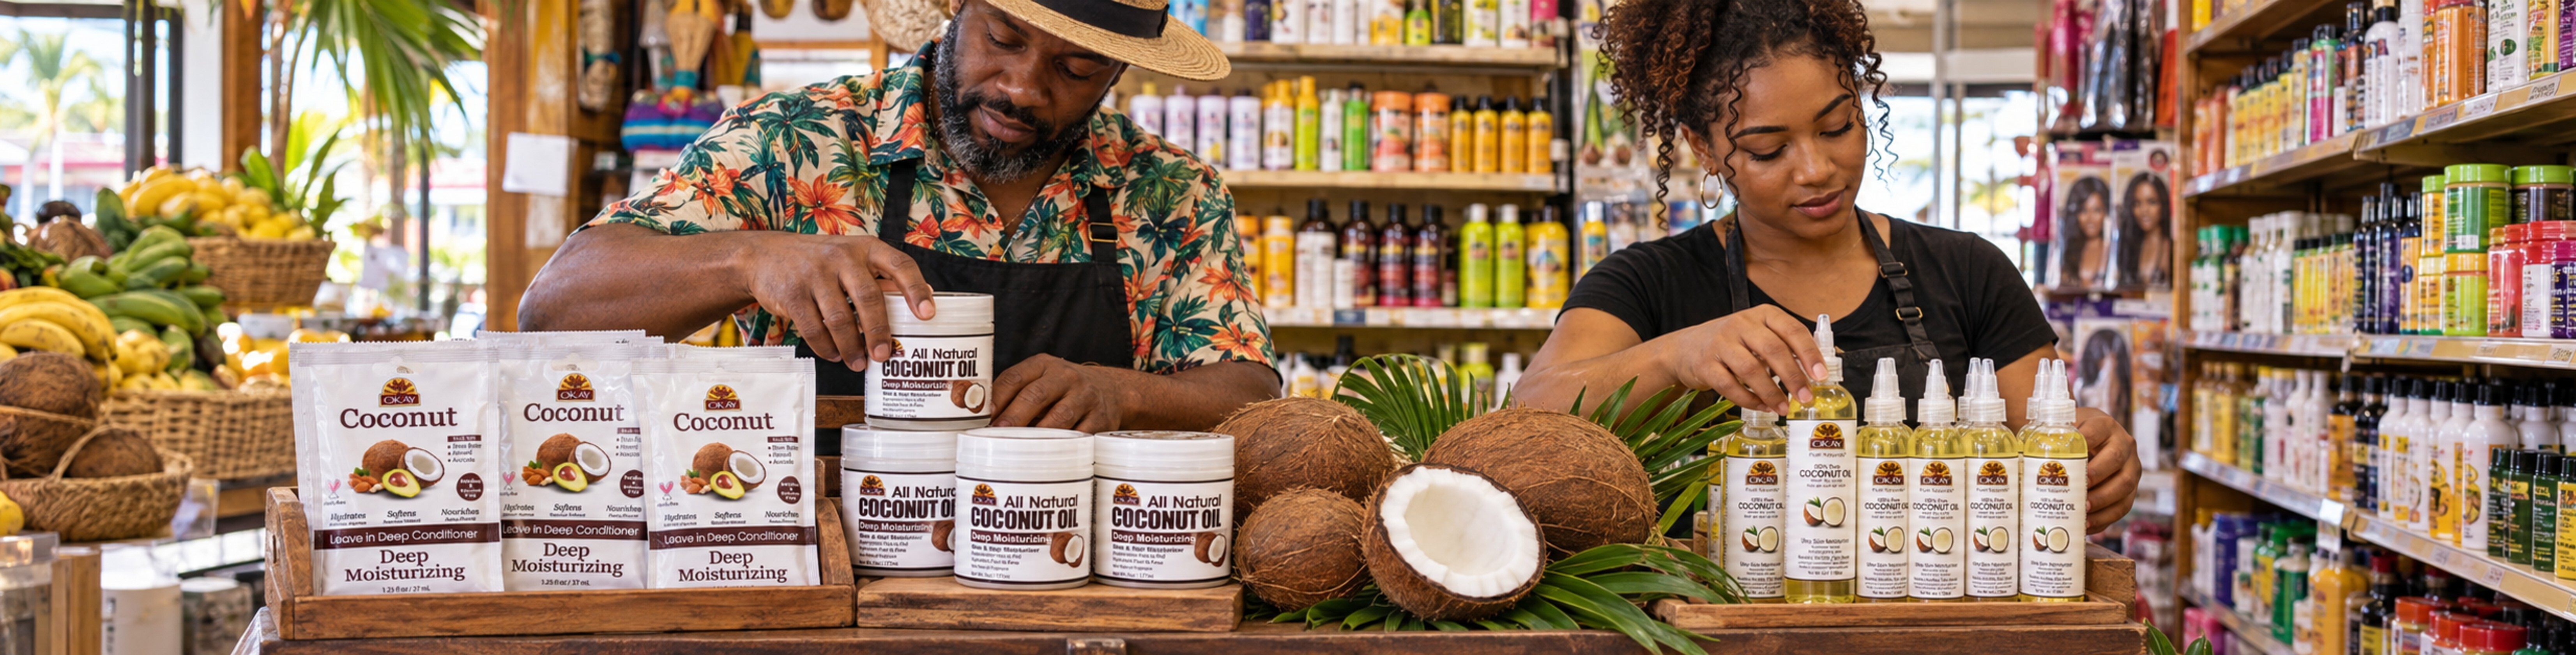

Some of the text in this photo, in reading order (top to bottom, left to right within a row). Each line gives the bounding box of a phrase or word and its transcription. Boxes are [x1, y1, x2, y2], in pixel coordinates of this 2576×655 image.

[911, 349, 927, 359] All
[933, 347, 978, 359] Natural
[882, 360, 978, 378] COCONUT OIL
[384, 396, 415, 404] OKAY
[560, 391, 590, 399] OKAY
[340, 408, 458, 428] Coconut
[524, 403, 624, 421] Coconut
[674, 412, 774, 432] Coconut
[1800, 469, 1841, 478] COCONUT
[892, 486, 909, 498] All
[915, 486, 955, 498] Natura
[859, 498, 955, 518] COCONUT OI
[1004, 494, 1078, 508] All Natural
[1147, 494, 1222, 508] All Natural
[1913, 503, 1949, 511] COCONUT
[2030, 502, 2065, 510] COCONUT
[971, 507, 1078, 530] COCONUT OIL
[1112, 506, 1221, 529] COCONUT OIL
[330, 529, 477, 545] Leave in Deep Conditioner
[502, 524, 639, 536] Leave in Deep Conditioner
[665, 531, 798, 545] Leave in Deep Conditioner
[380, 549, 428, 566] Deep
[543, 543, 590, 561] Deep
[709, 551, 753, 567] Deep
[345, 564, 465, 581] Moisturizing
[511, 559, 624, 578] Moisturizing
[678, 566, 788, 582] Moisturizing
